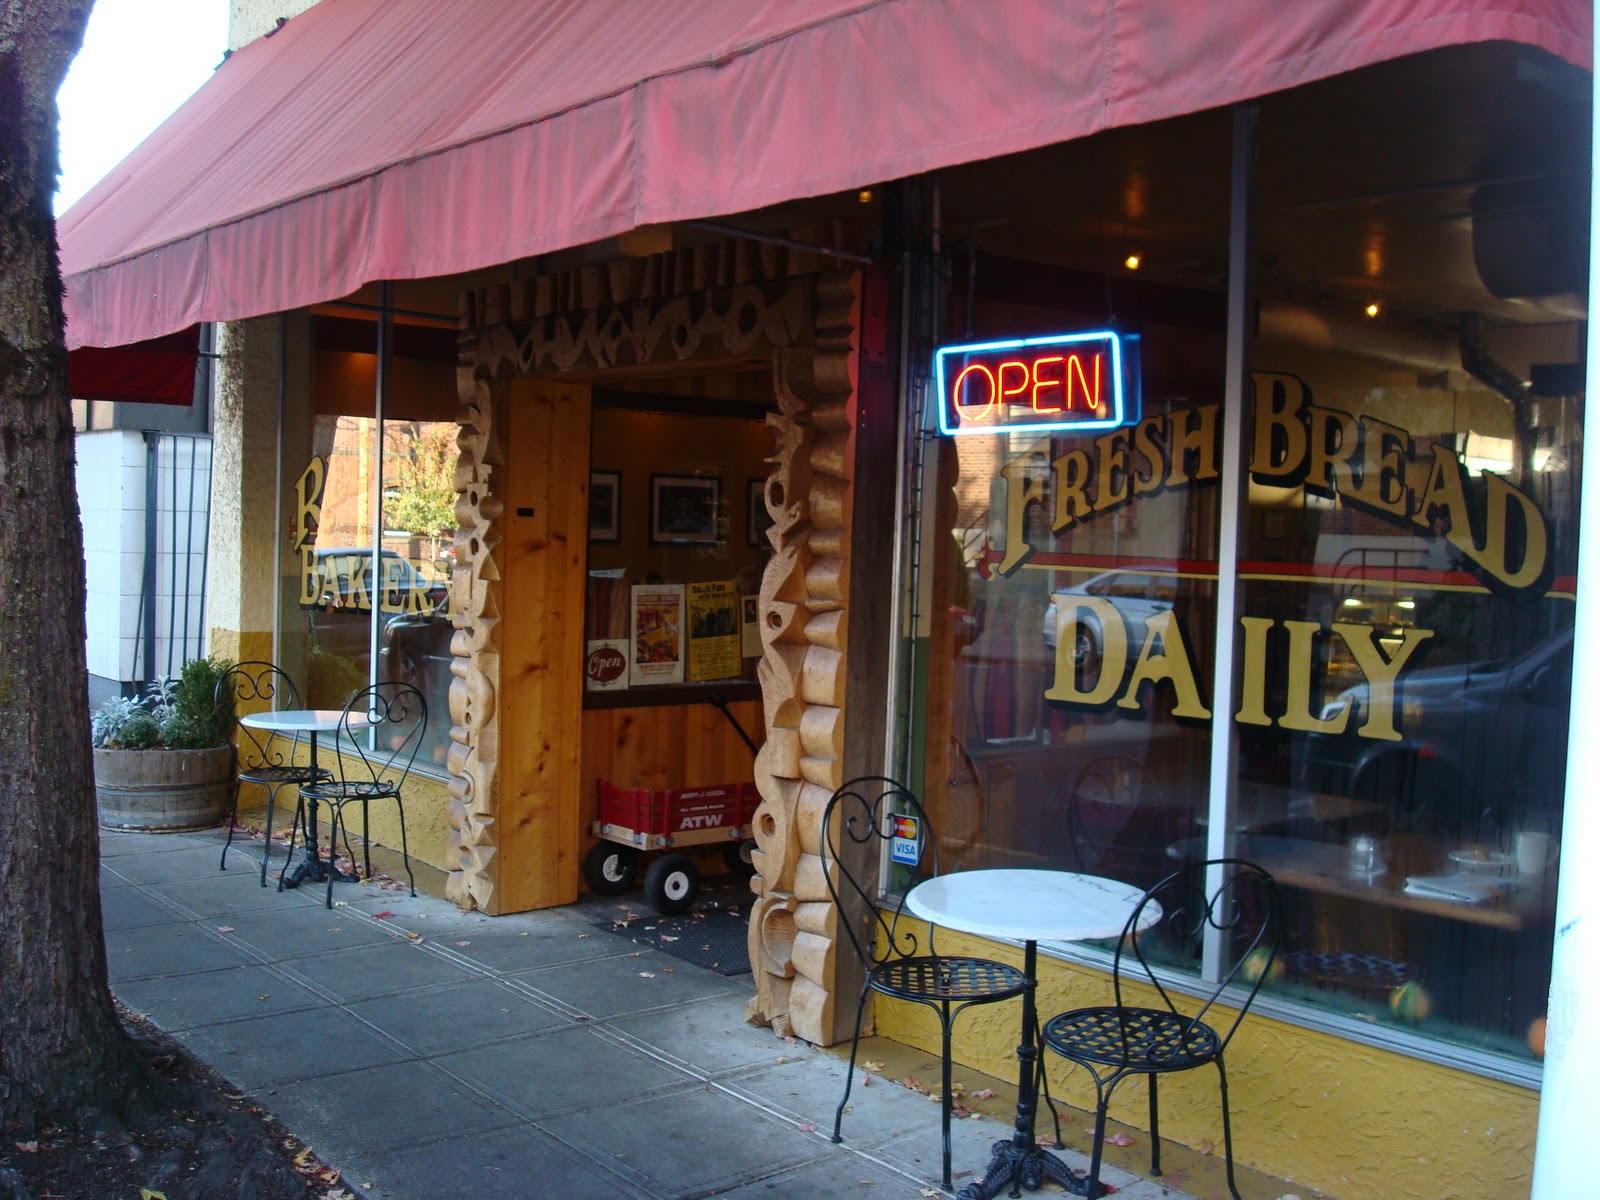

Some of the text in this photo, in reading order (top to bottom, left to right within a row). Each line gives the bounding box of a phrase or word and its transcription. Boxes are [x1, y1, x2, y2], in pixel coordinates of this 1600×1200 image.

[953, 354, 1101, 422] OPEN
[998, 372, 1547, 589] FRESH BREAD
[588, 653, 621, 678] Open
[1044, 592, 1435, 741] DAILY
[679, 813, 724, 830] ATW
[896, 842, 916, 856] VISA
